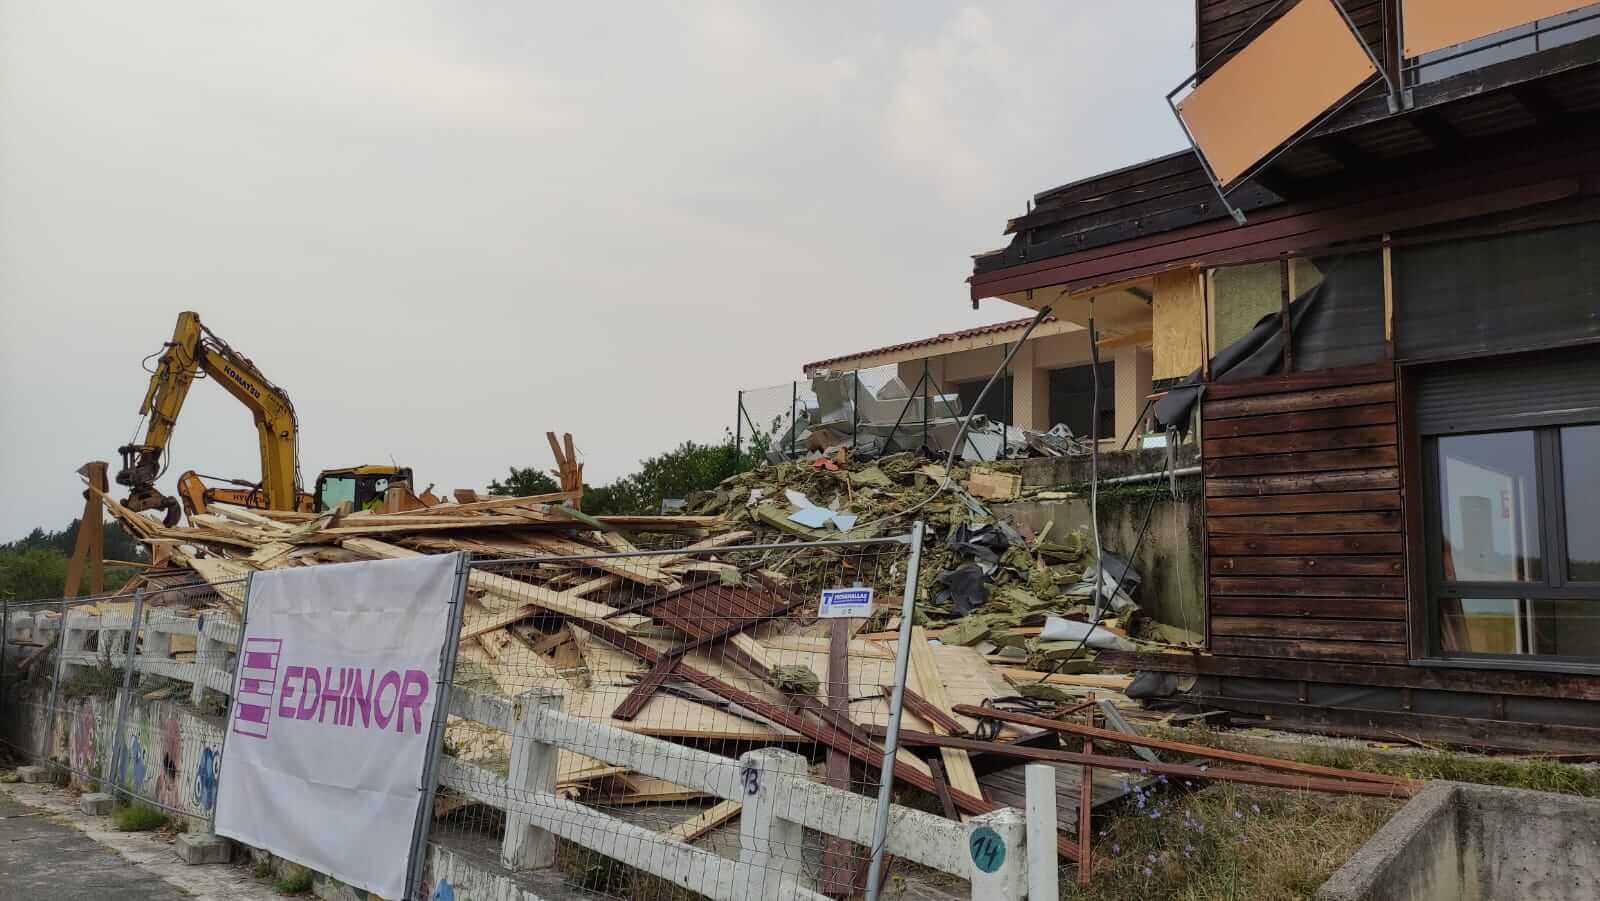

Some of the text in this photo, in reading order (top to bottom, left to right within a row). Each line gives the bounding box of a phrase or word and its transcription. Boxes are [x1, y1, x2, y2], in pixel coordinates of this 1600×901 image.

[224, 366, 261, 399] KOMATSU
[278, 666, 429, 734] EDHINOR
[742, 767, 759, 795] 13
[972, 836, 998, 869] 14
